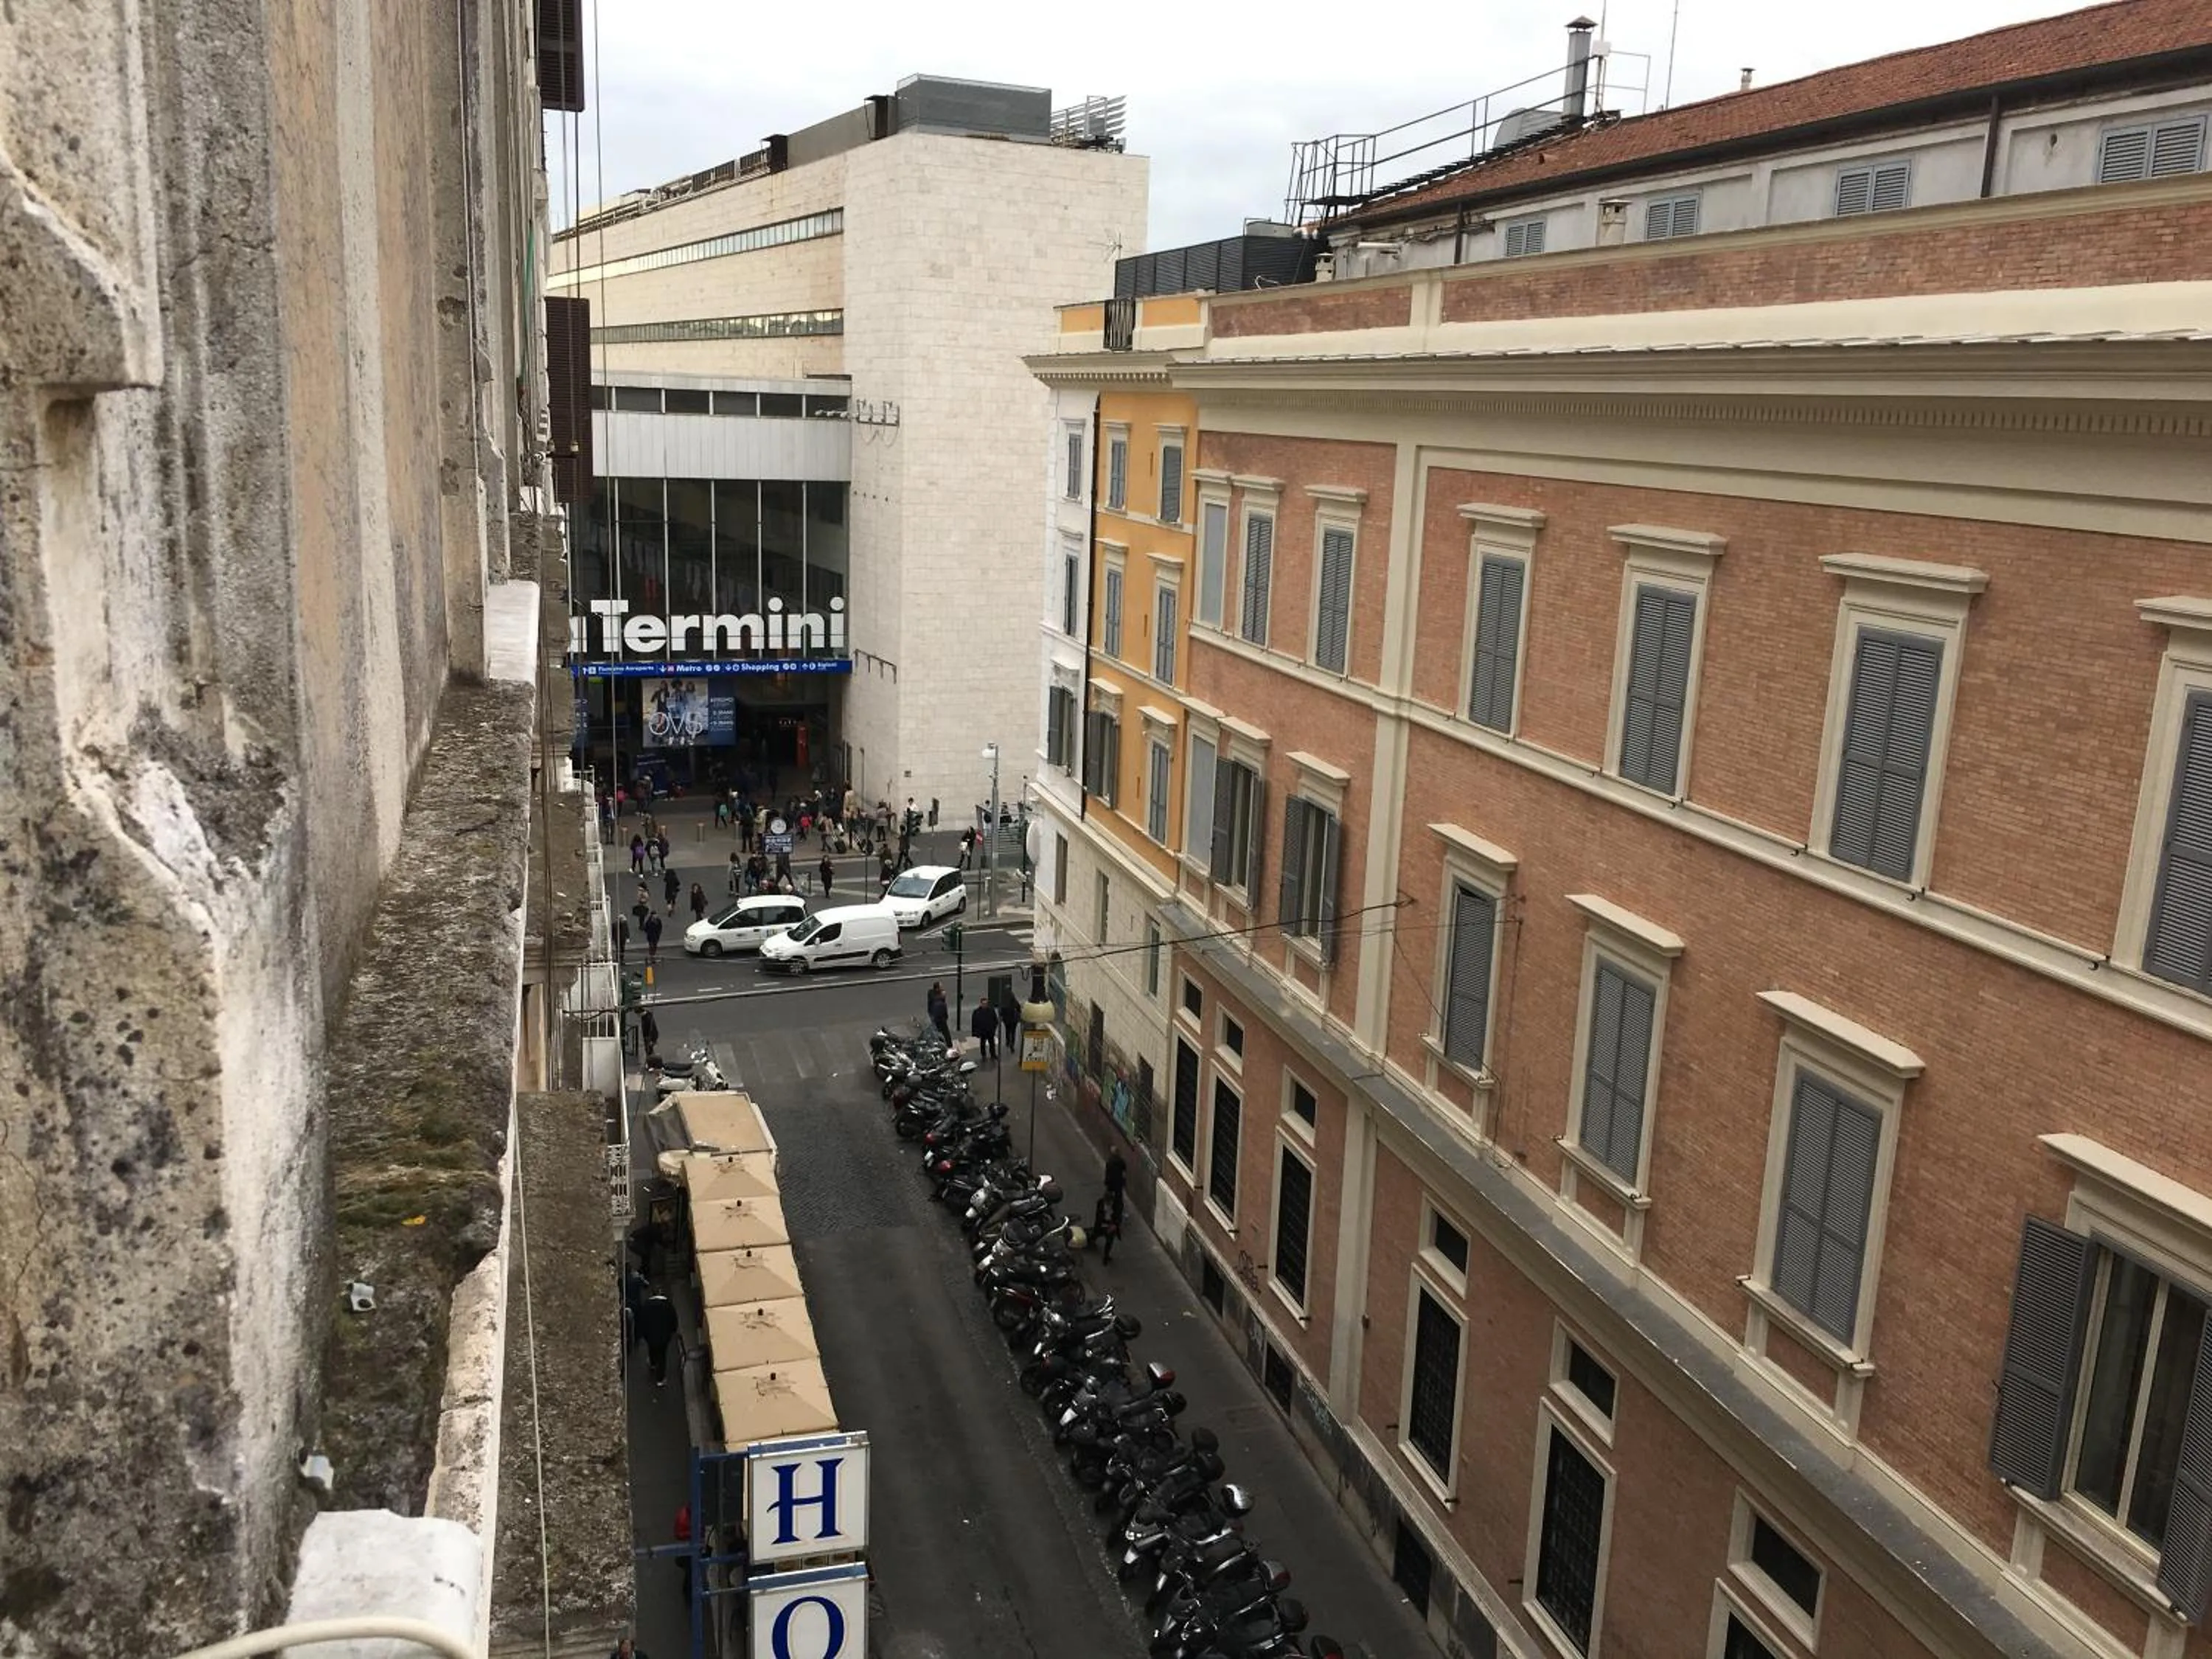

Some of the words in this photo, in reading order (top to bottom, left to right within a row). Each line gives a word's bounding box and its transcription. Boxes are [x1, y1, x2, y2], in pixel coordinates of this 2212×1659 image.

[590, 597, 844, 653] Termini
[676, 664, 703, 672] Metro
[741, 662, 779, 672] Shopping
